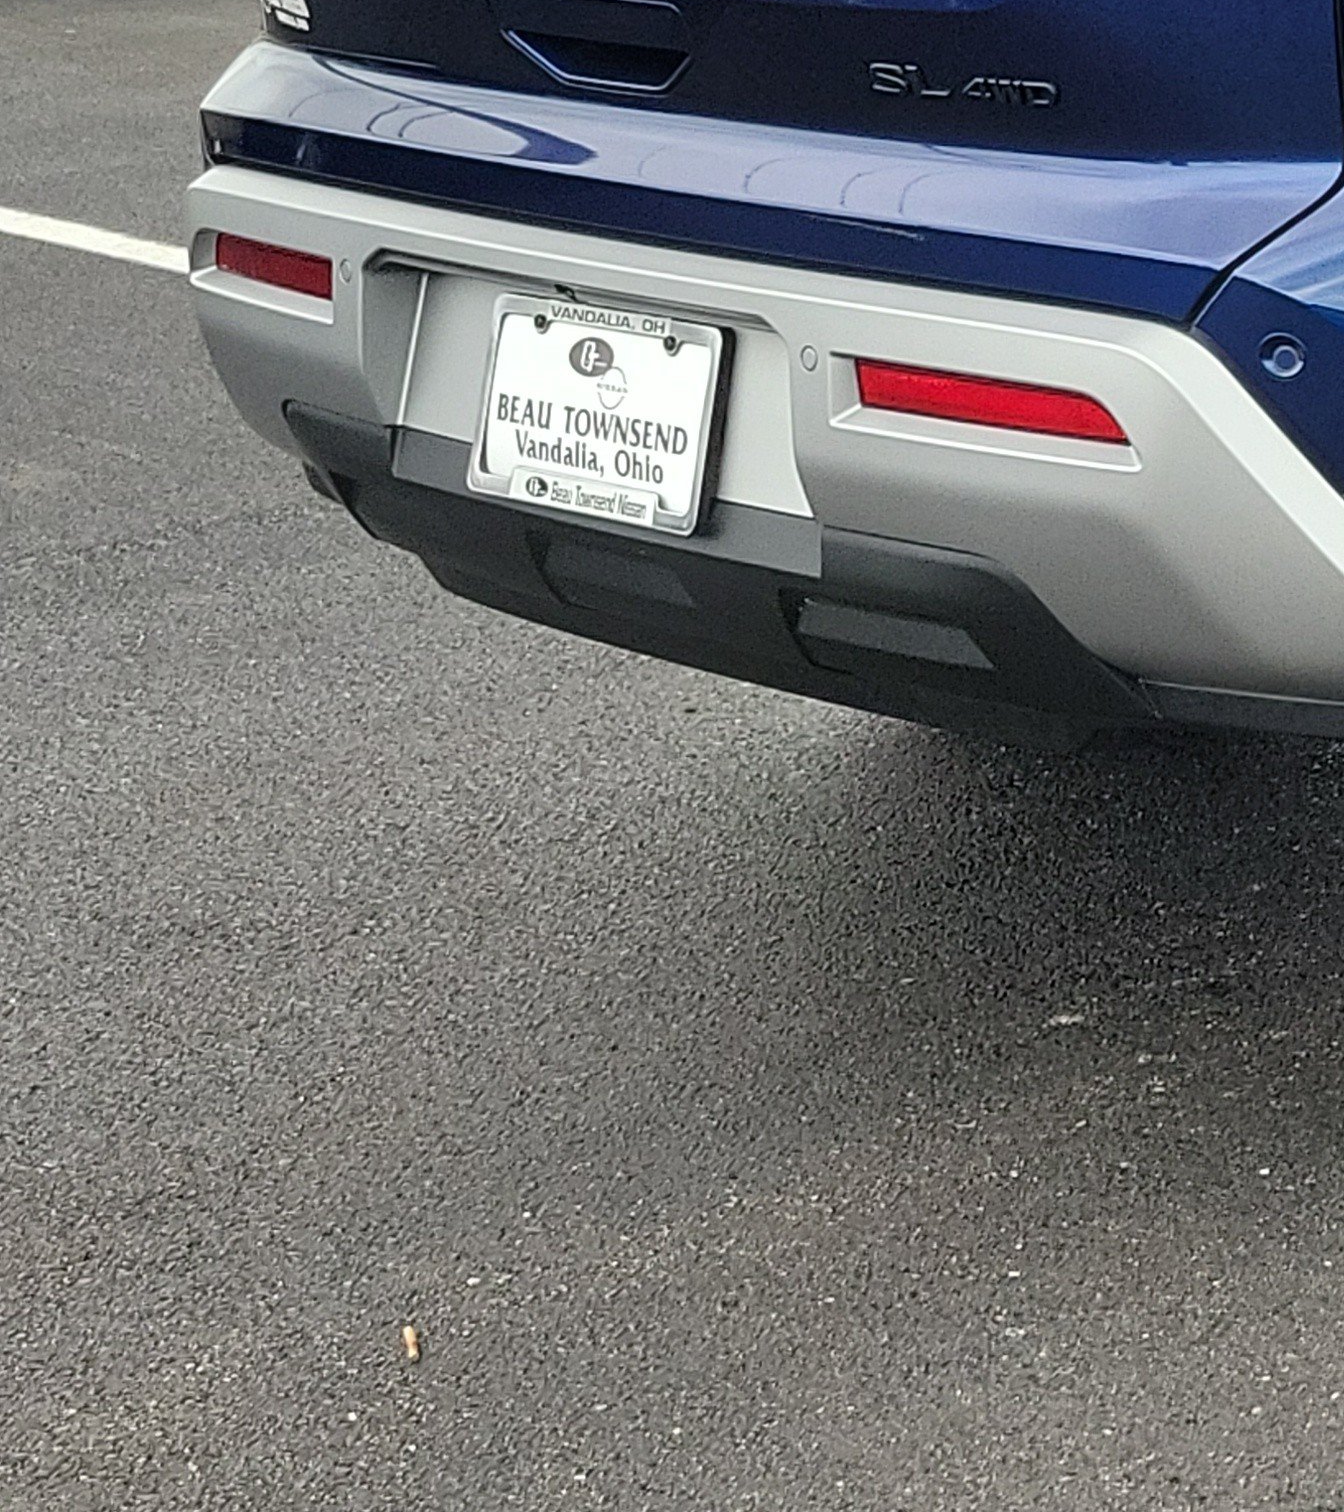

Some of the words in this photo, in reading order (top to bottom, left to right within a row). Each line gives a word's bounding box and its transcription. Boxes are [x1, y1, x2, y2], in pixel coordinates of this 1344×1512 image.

[868, 62, 950, 96] SL
[551, 305, 635, 330] VANDALIA,
[642, 318, 666, 334] OH
[497, 392, 553, 430] BEAU
[564, 405, 688, 455] TOWNSEND
[515, 428, 604, 477] Vandalia,
[615, 449, 664, 484] Ohio
